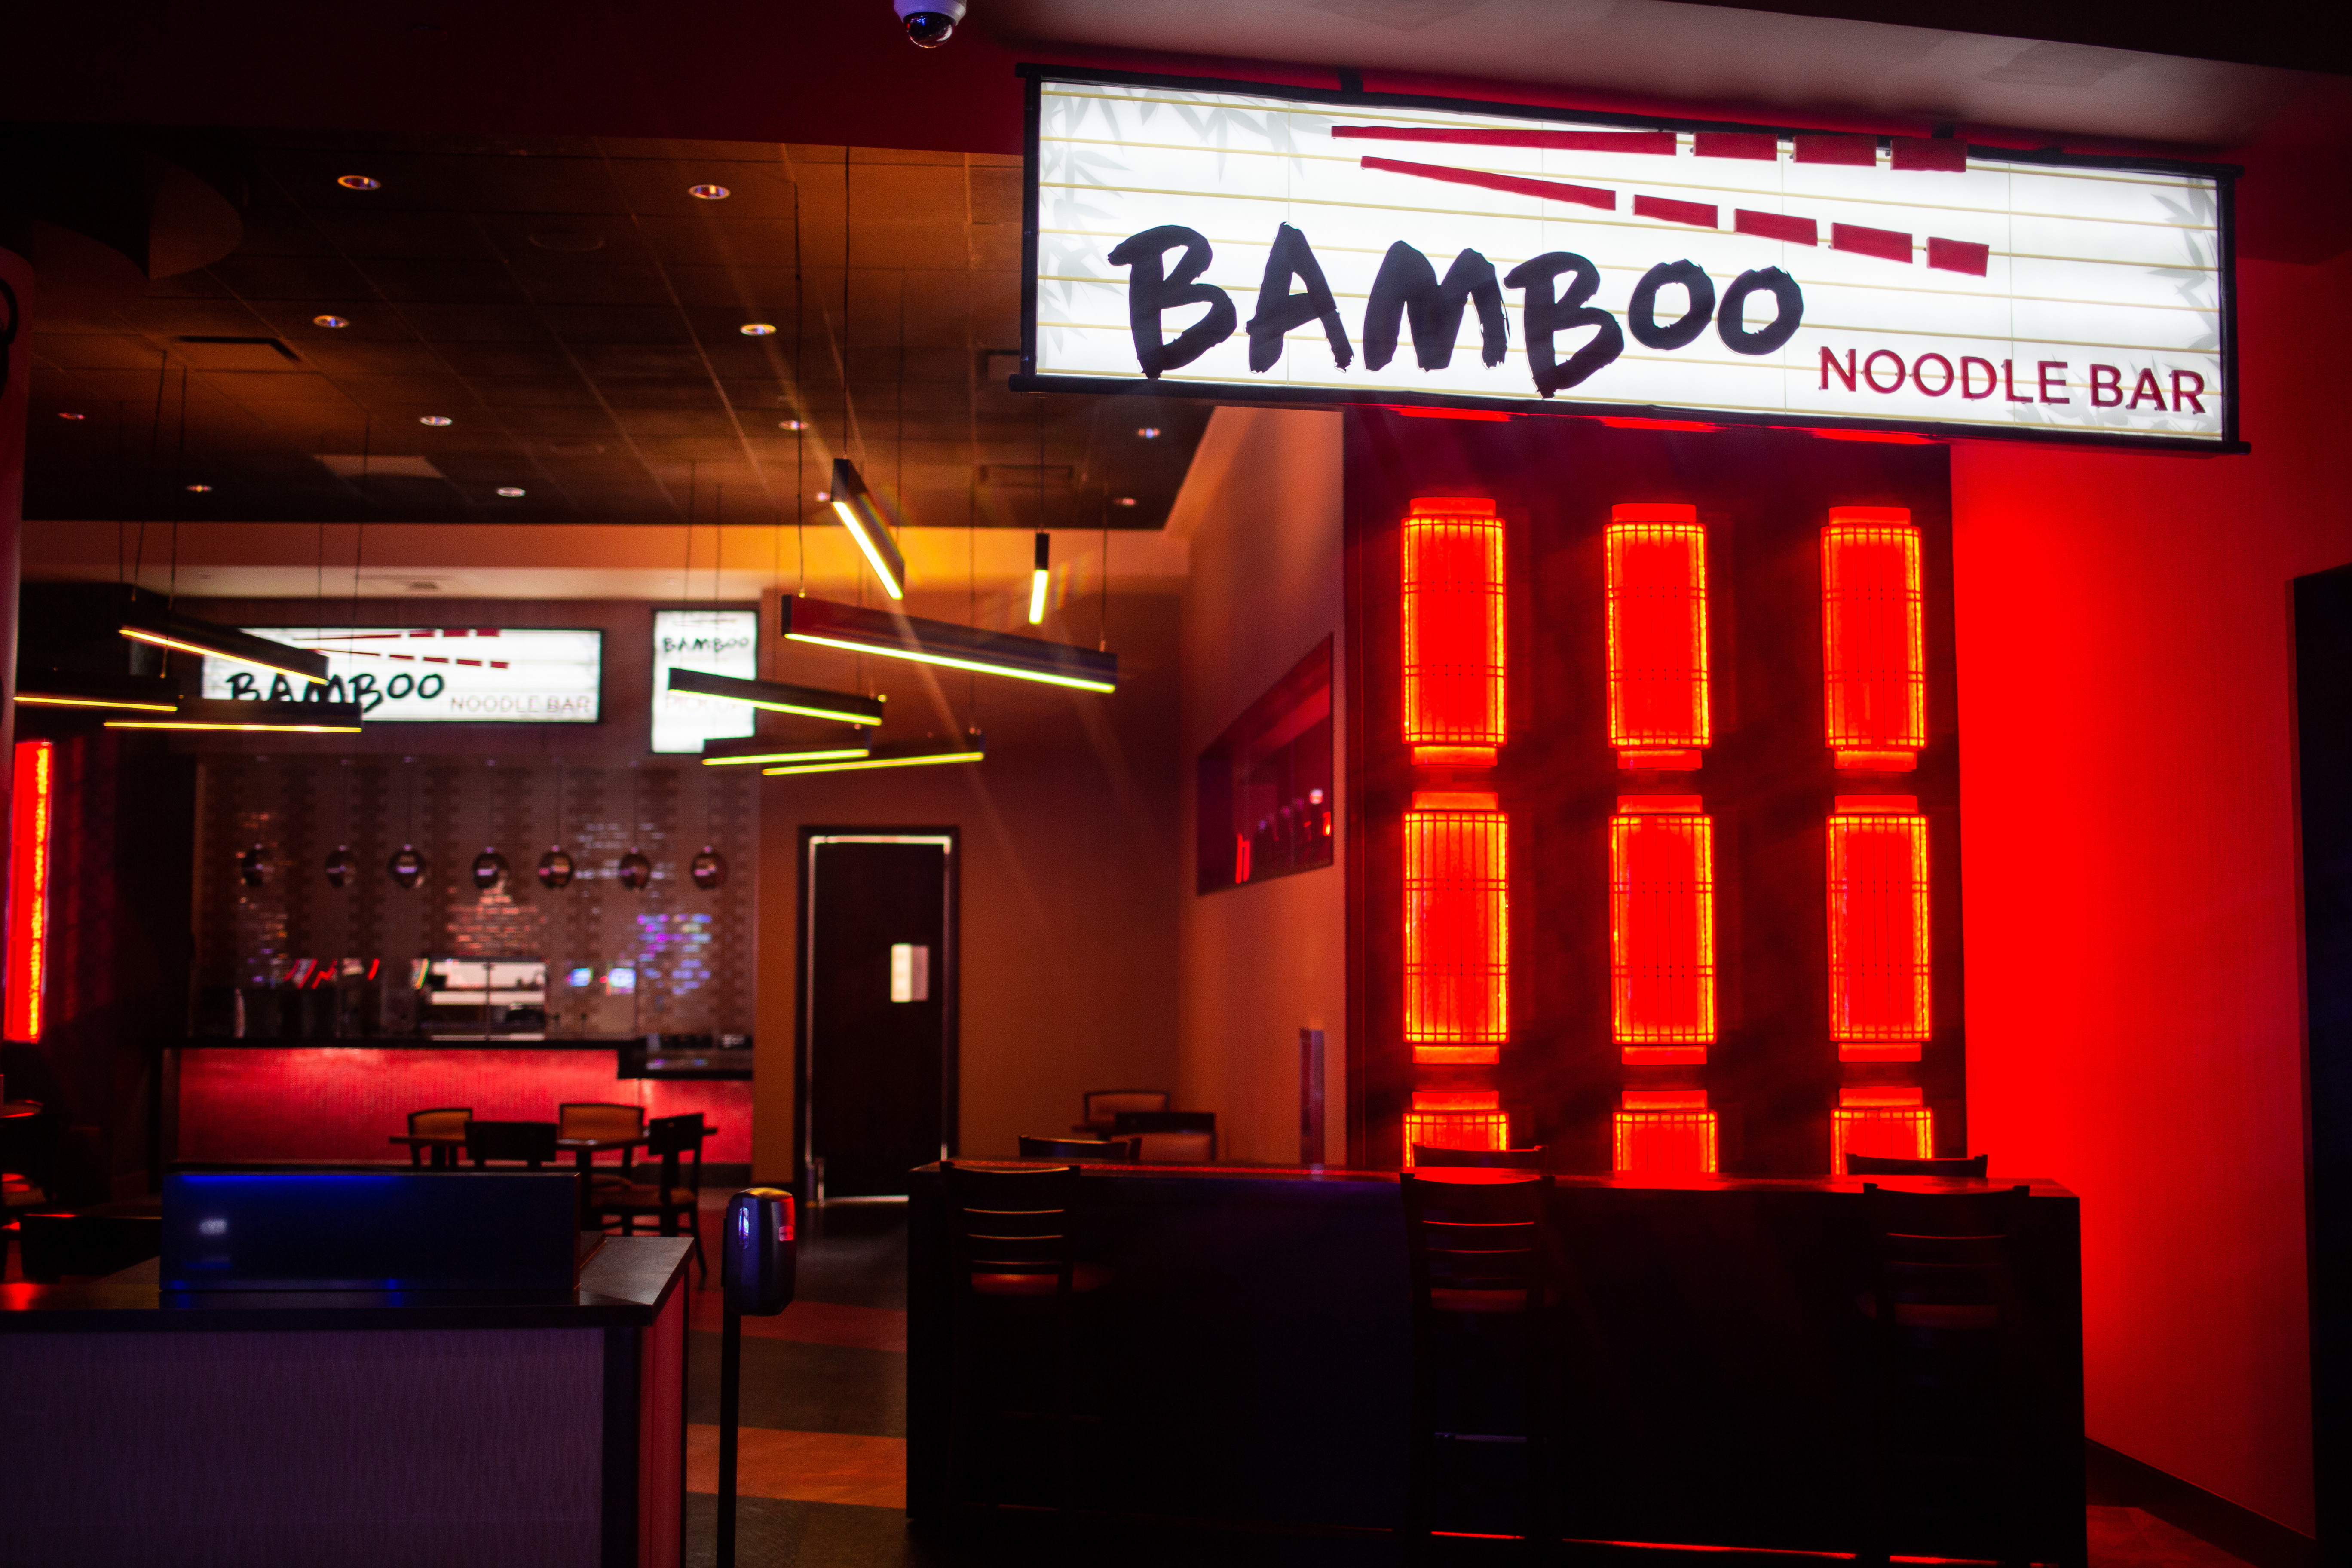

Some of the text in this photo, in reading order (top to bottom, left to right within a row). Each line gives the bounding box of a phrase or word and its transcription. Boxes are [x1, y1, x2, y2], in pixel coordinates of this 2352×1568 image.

[1108, 221, 1804, 399] BAMBOO
[1819, 346, 2205, 414] NOODLE BAR
[662, 637, 749, 653] BAMBOO
[225, 673, 445, 714] BAMBOO
[451, 695, 590, 714] NOODLE BAR
